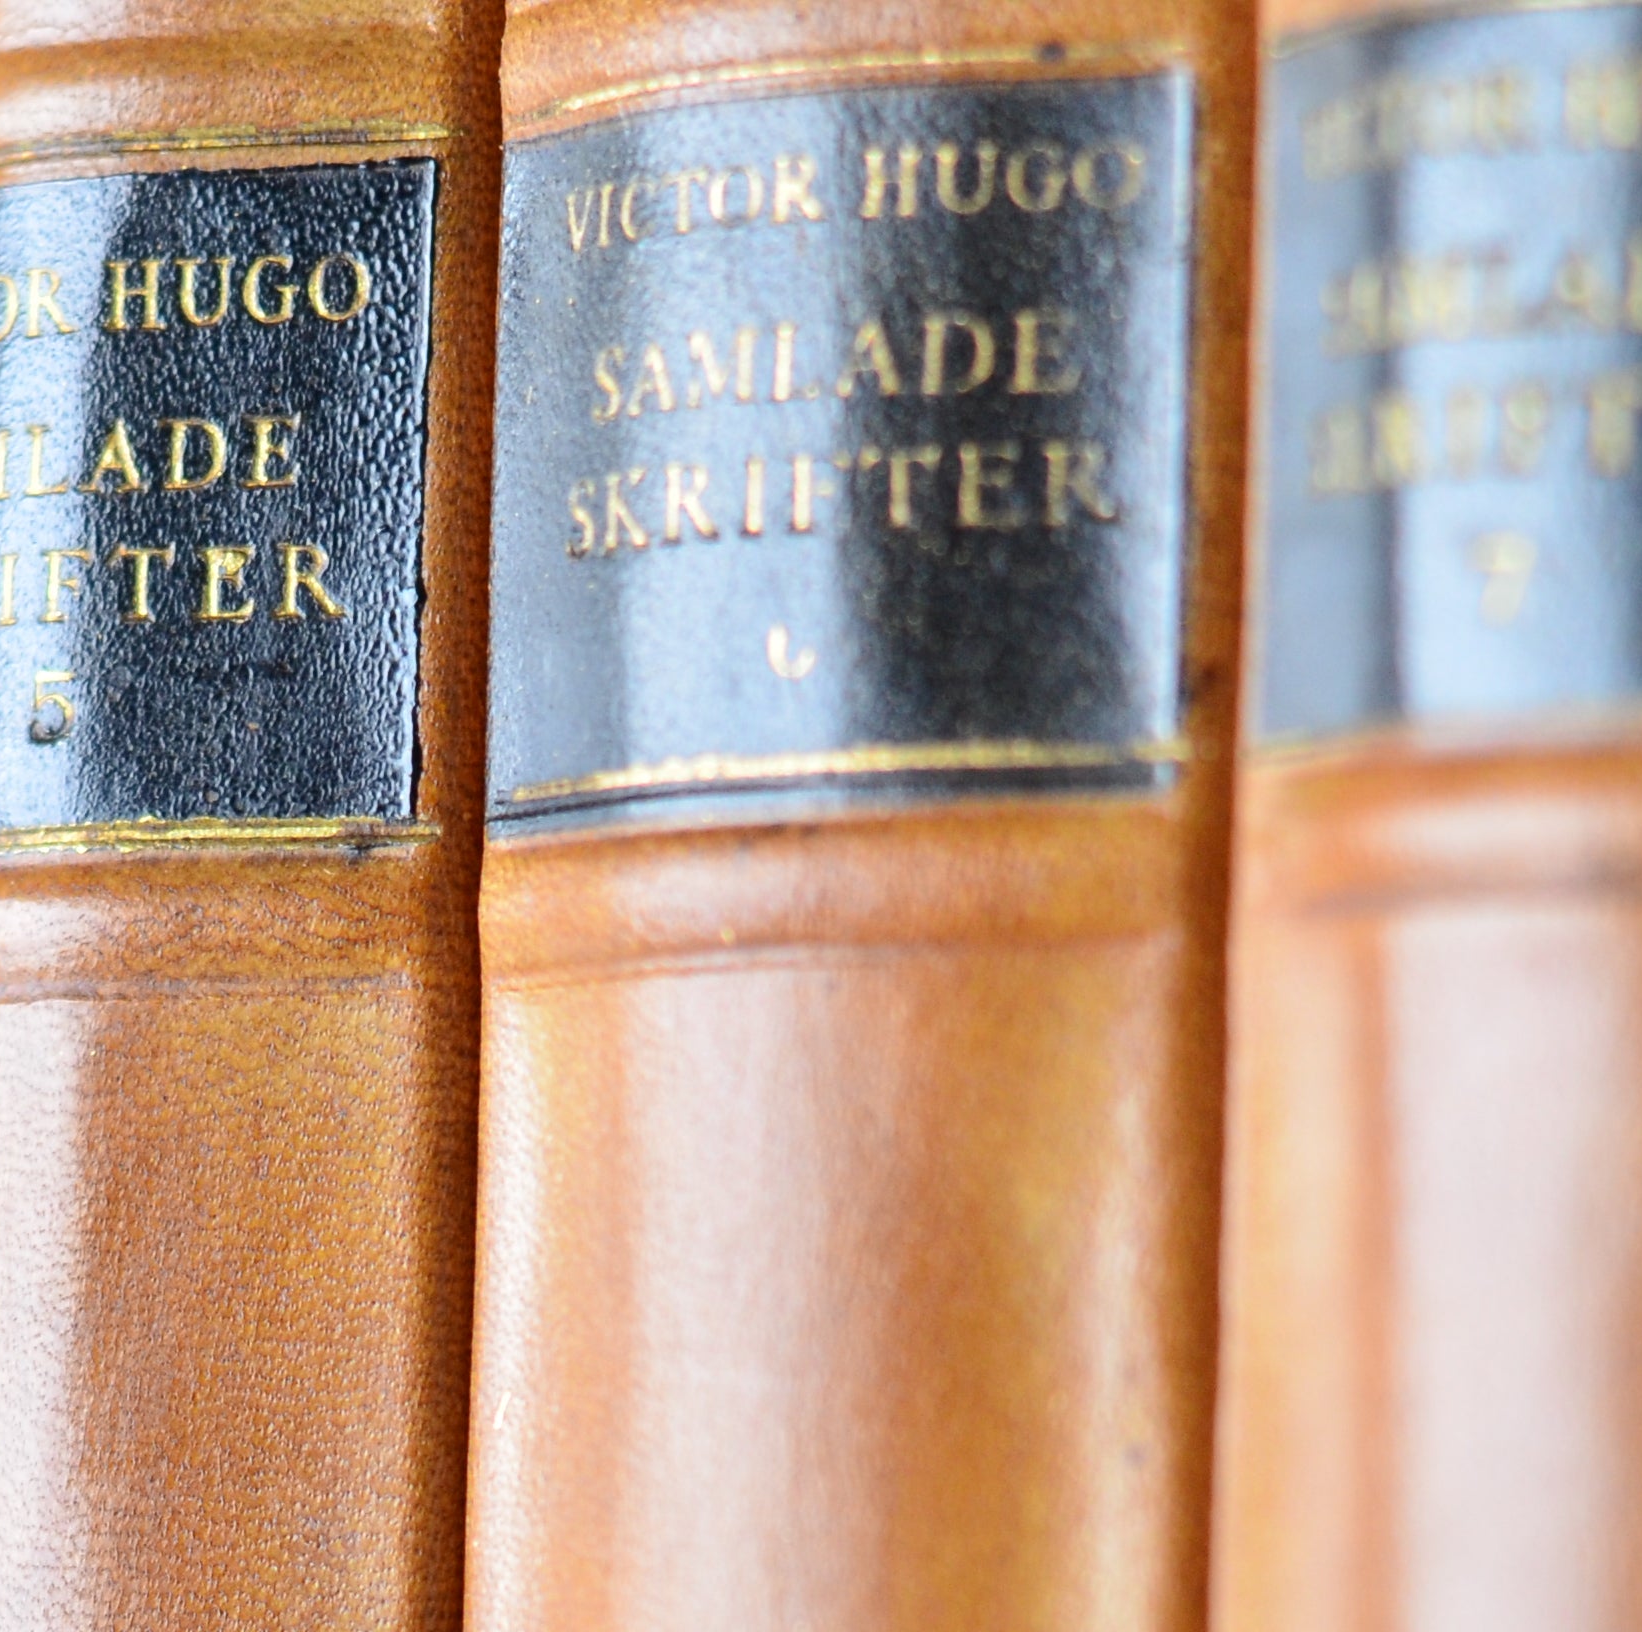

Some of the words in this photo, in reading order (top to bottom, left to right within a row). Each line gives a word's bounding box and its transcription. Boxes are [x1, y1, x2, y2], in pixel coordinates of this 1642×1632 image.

[566, 153, 825, 252] VICTOR
[859, 139, 1146, 220] HUGO
[102, 254, 370, 330] HUGO
[592, 306, 1082, 422] SAMLADE
[566, 440, 1120, 559] SKRIFTER
[30, 670, 76, 742] 5
